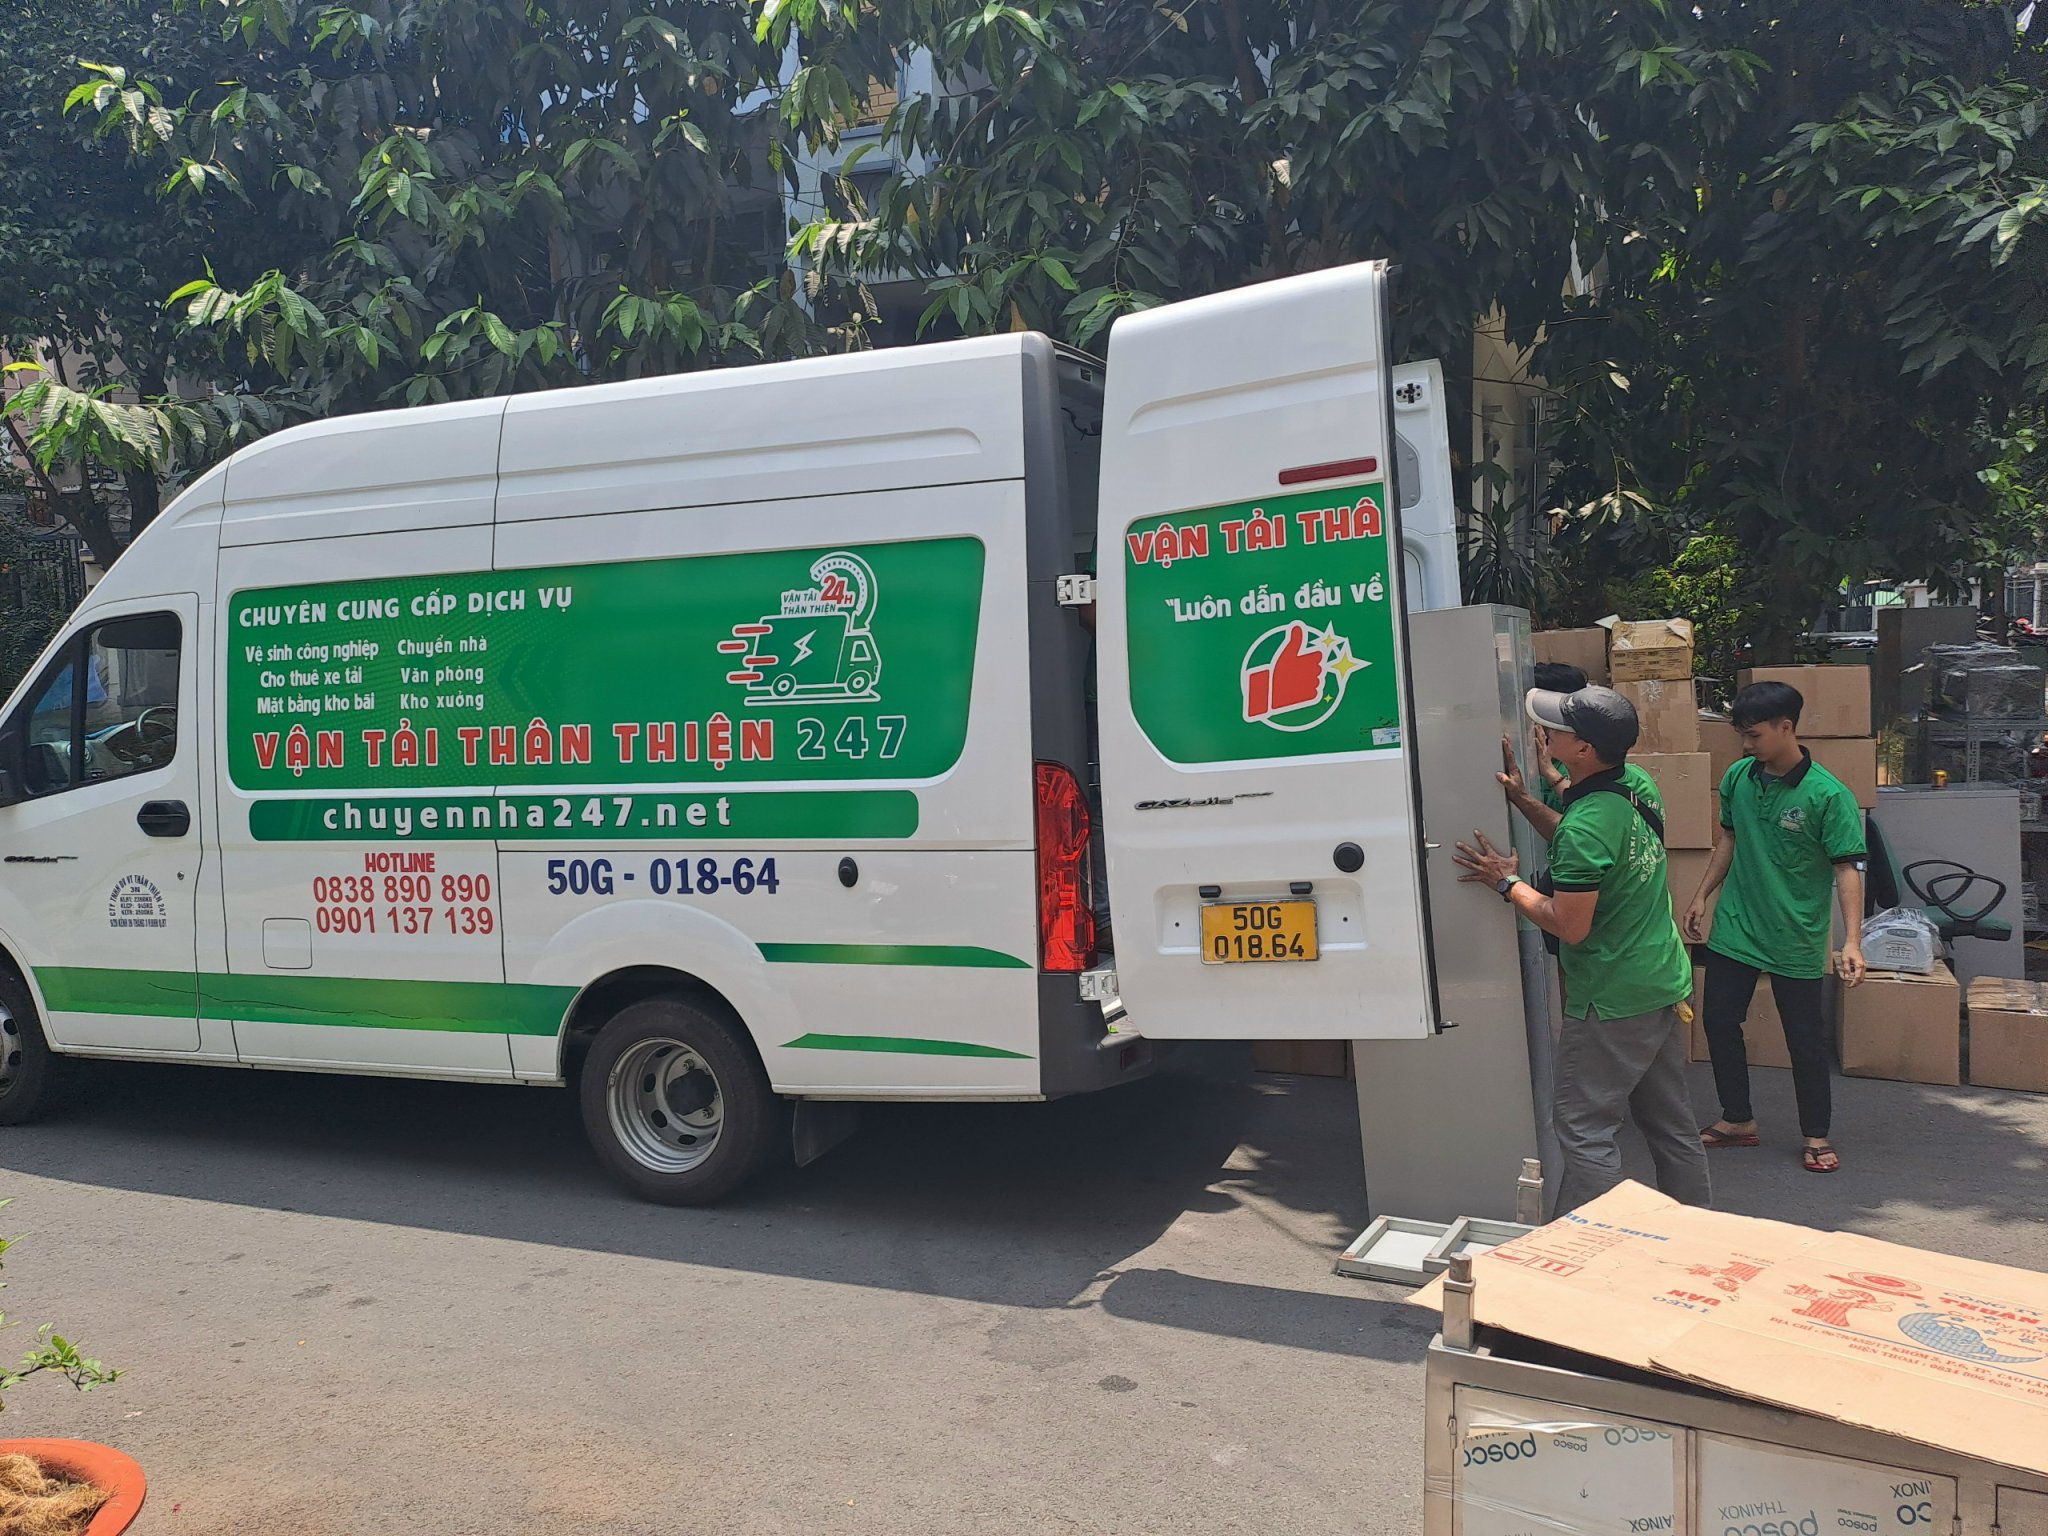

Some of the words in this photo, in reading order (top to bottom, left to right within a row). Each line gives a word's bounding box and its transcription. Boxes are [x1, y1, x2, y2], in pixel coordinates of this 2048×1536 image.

[1127, 522, 1209, 568] VẬN
[1220, 508, 1286, 554] TẢI
[783, 592, 800, 605] VẬN
[803, 590, 817, 602] TẢI
[1240, 584, 1285, 614] dẫn
[1294, 578, 1340, 609] đầu
[1351, 572, 1383, 603] về
[239, 600, 326, 627] CHUYÊN
[337, 598, 399, 621] CUNG
[411, 588, 457, 616] CẤP
[468, 589, 525, 617] DỊCH
[538, 586, 572, 612] VỤ
[783, 605, 806, 615] THÂN
[810, 602, 836, 615] THIỆN
[244, 645, 263, 666] Vệ
[267, 644, 292, 661] sinh
[297, 643, 329, 663] công
[333, 640, 379, 662] nghiệp
[397, 635, 452, 658] Chuyển
[459, 635, 487, 652] nhà
[260, 671, 285, 688] Cho
[290, 669, 319, 687] thuê
[324, 671, 340, 685] xe
[345, 665, 362, 684] tải
[401, 667, 428, 683] Văn
[436, 665, 484, 686] phòng
[257, 697, 284, 717] Mặt
[288, 693, 320, 716] bằng
[325, 694, 349, 711] kho
[354, 692, 375, 710] bãi
[400, 694, 428, 709] Kho
[253, 724, 344, 777] VẬN
[362, 718, 438, 766] TẢI
[458, 717, 591, 765] THÂN
[612, 712, 773, 771] THIỆN
[797, 715, 907, 760] 247
[322, 797, 731, 836] chuyennha247.net
[365, 853, 435, 872] HOTLINE
[547, 859, 614, 895] 50G
[650, 857, 780, 895] 018-64
[313, 876, 375, 903] 0838
[384, 875, 431, 903] 890
[441, 874, 490, 902] 890
[316, 906, 376, 934] 0901
[387, 906, 433, 934] 137
[444, 907, 493, 934] 139
[1233, 906, 1281, 930] 50G
[1214, 933, 1304, 959] 018.64
[1553, 1438, 1588, 1452] posco
[1718, 1501, 1787, 1521] THAINOX
[1837, 1517, 1878, 1533] posco
